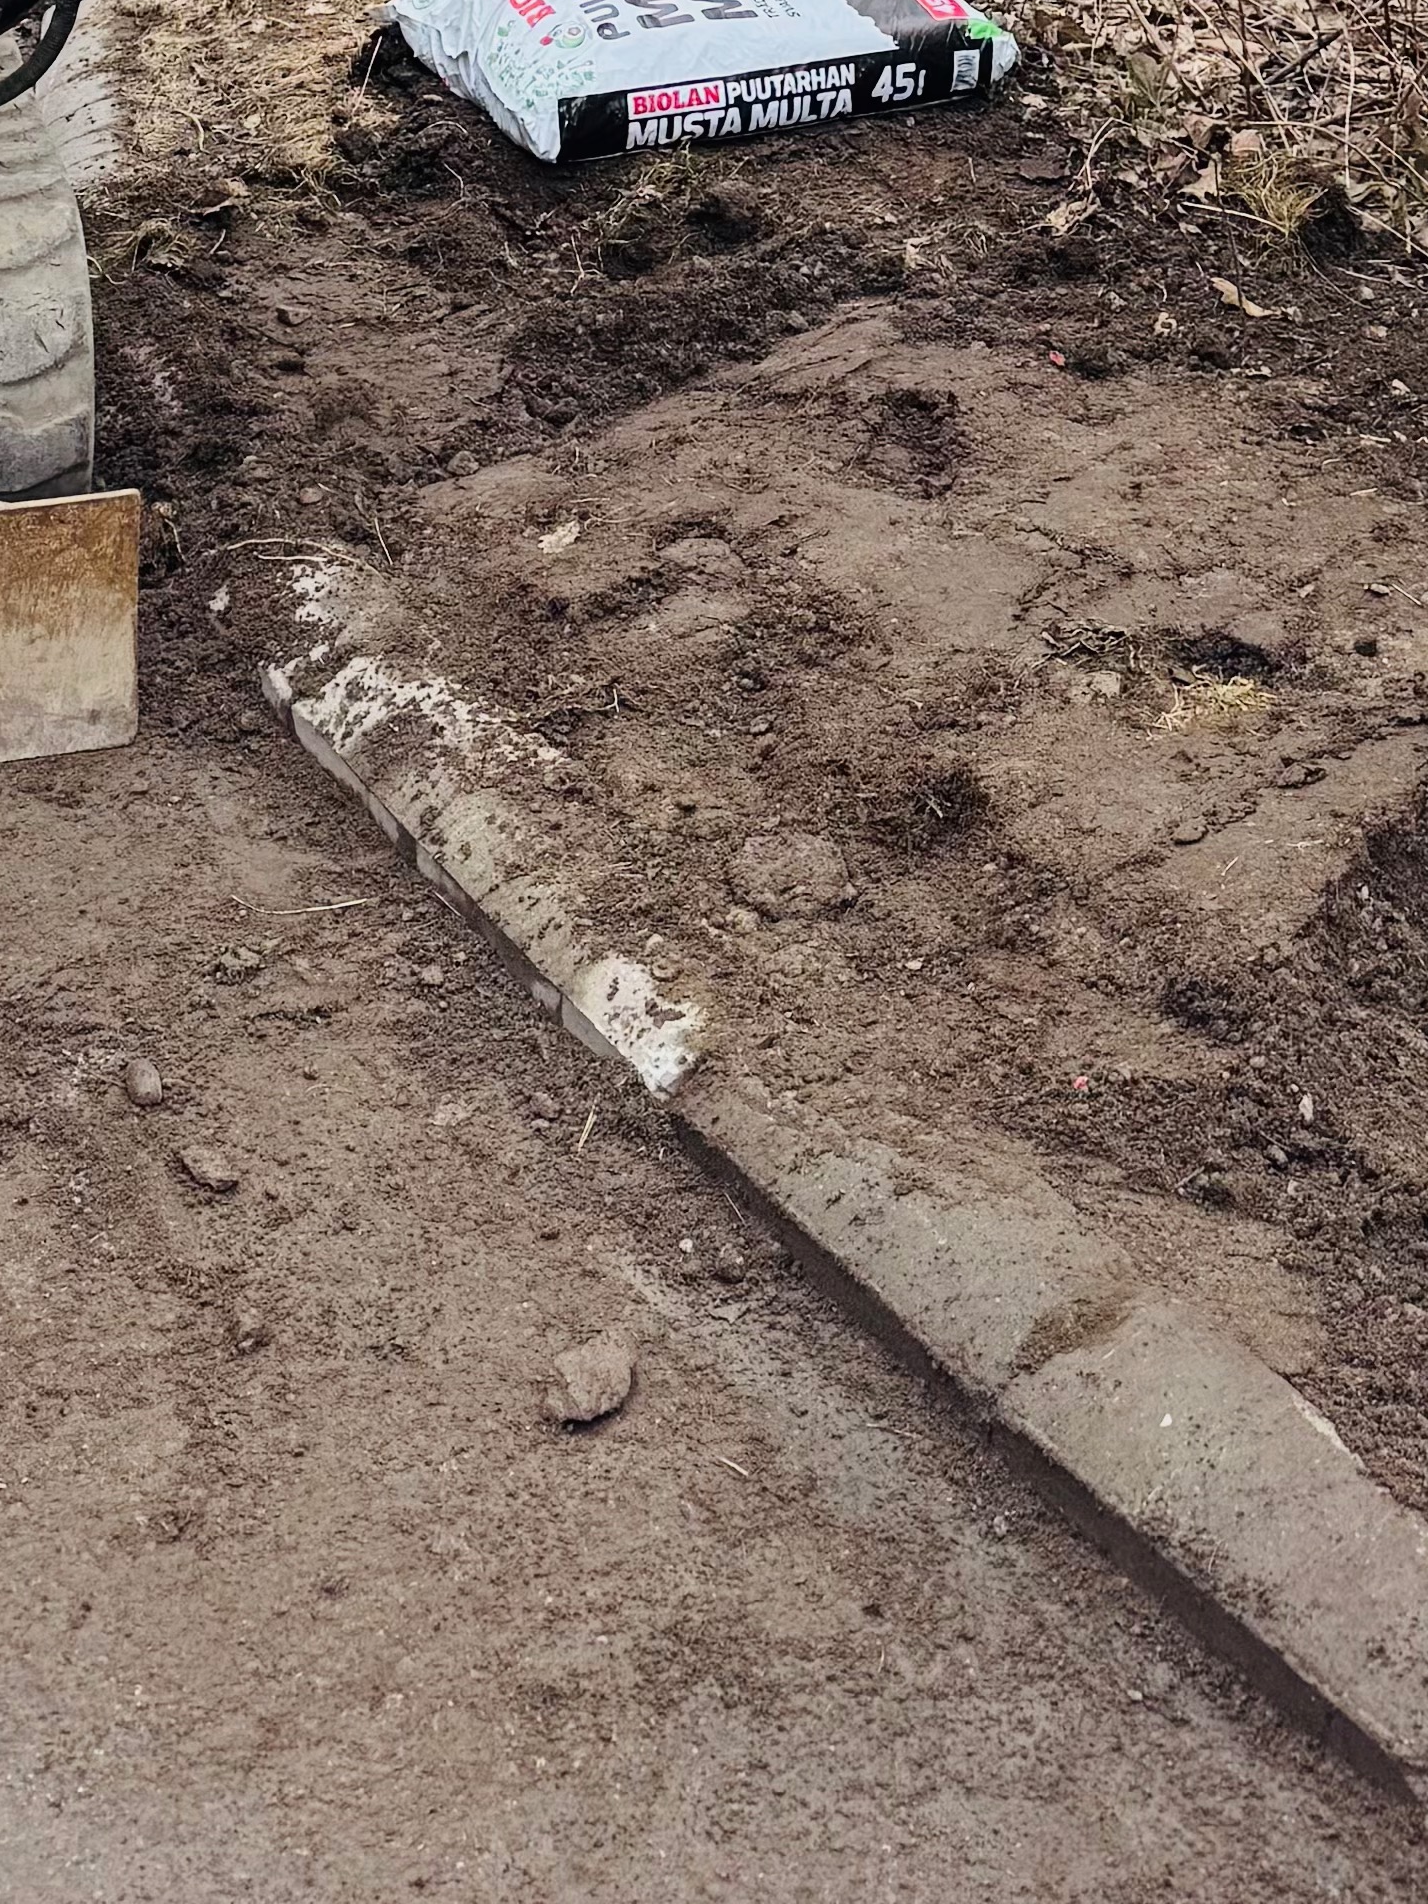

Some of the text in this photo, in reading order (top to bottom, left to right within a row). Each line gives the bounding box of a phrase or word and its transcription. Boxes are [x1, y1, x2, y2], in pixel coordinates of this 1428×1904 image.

[632, 62, 856, 116] BIOLAN PUUTARHAN
[626, 89, 853, 150] MUSTA MULTA
